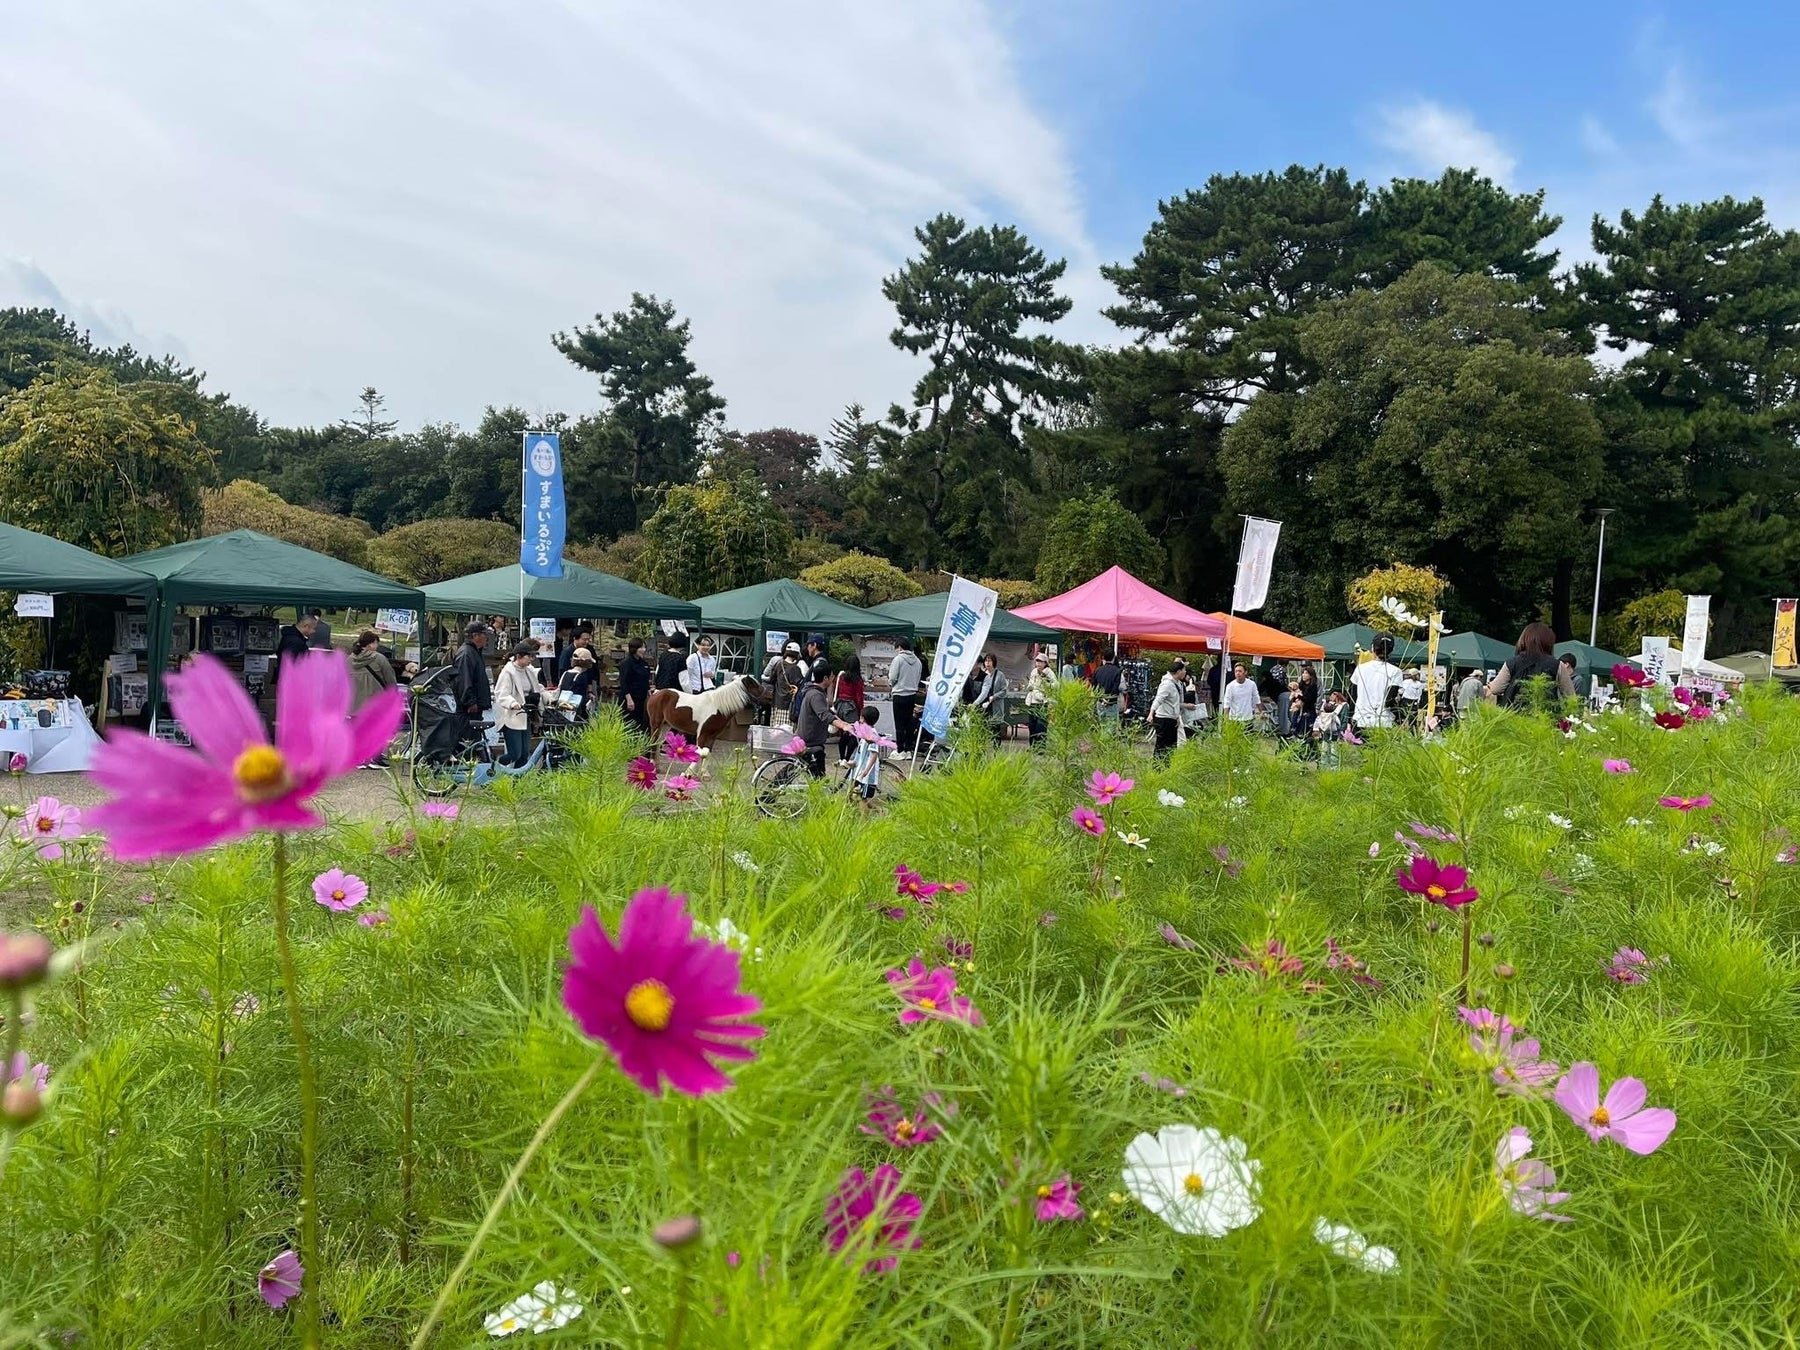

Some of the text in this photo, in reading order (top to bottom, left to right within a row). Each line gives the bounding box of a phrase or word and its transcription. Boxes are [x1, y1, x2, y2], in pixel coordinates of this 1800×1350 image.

[535, 480, 552, 566] すまいるぷろ
[389, 614, 409, 624] K-09
[935, 602, 981, 696] 暮らしの
